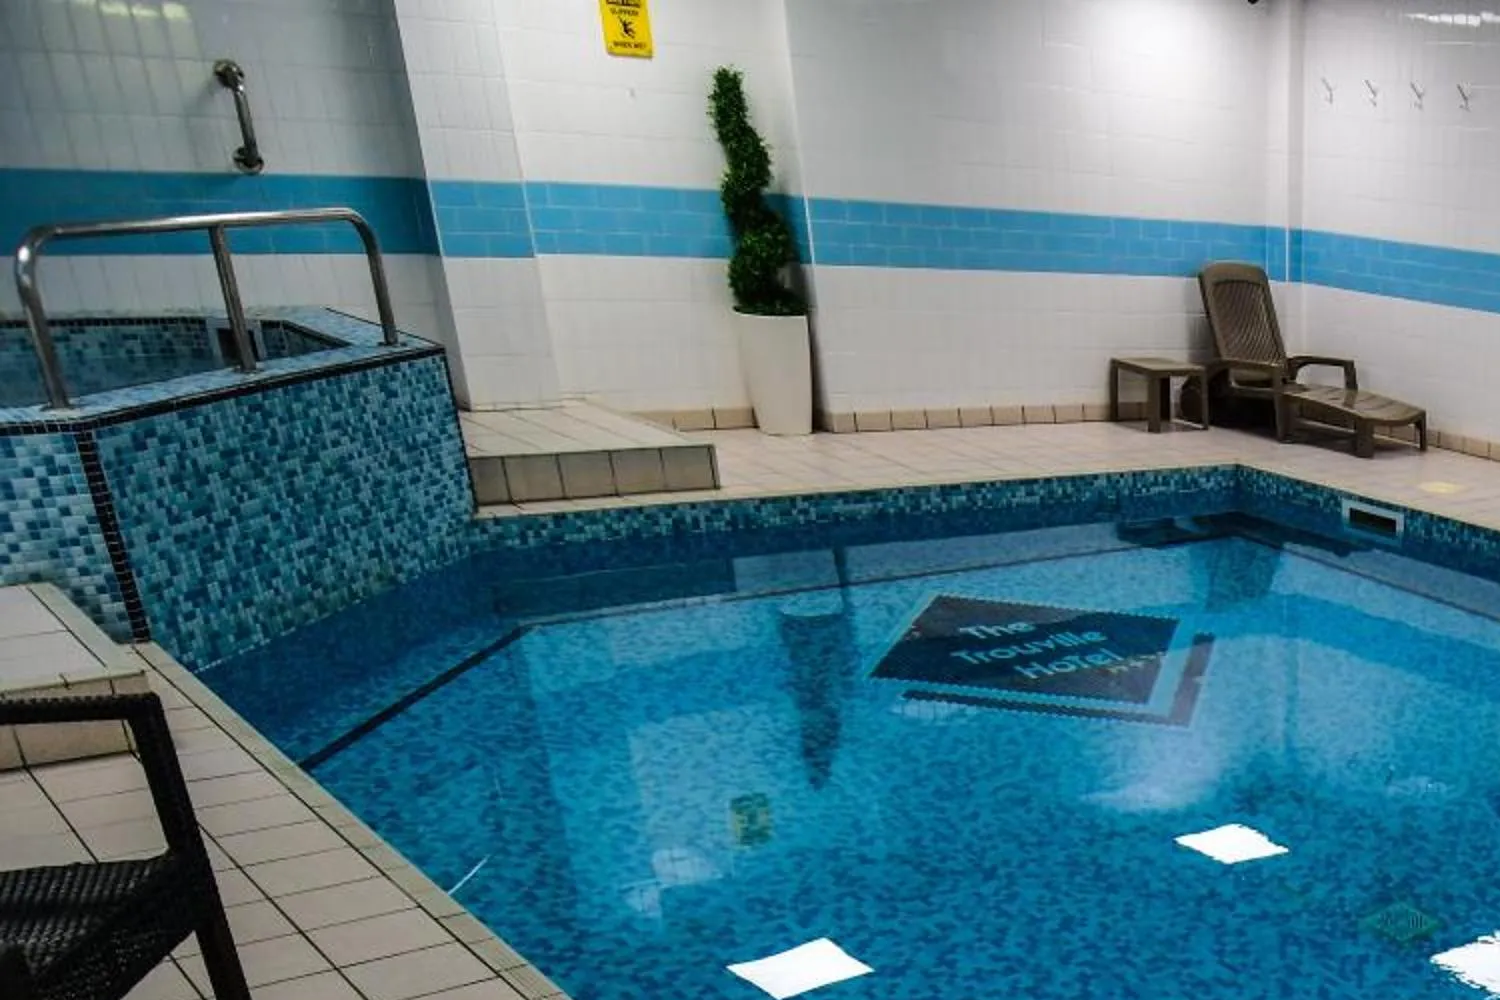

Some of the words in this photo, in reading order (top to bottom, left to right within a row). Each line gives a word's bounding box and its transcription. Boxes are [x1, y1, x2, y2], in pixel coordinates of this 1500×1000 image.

[958, 621, 1035, 640] The
[951, 631, 1107, 665] Trouville
[1013, 647, 1124, 680] Hotel
